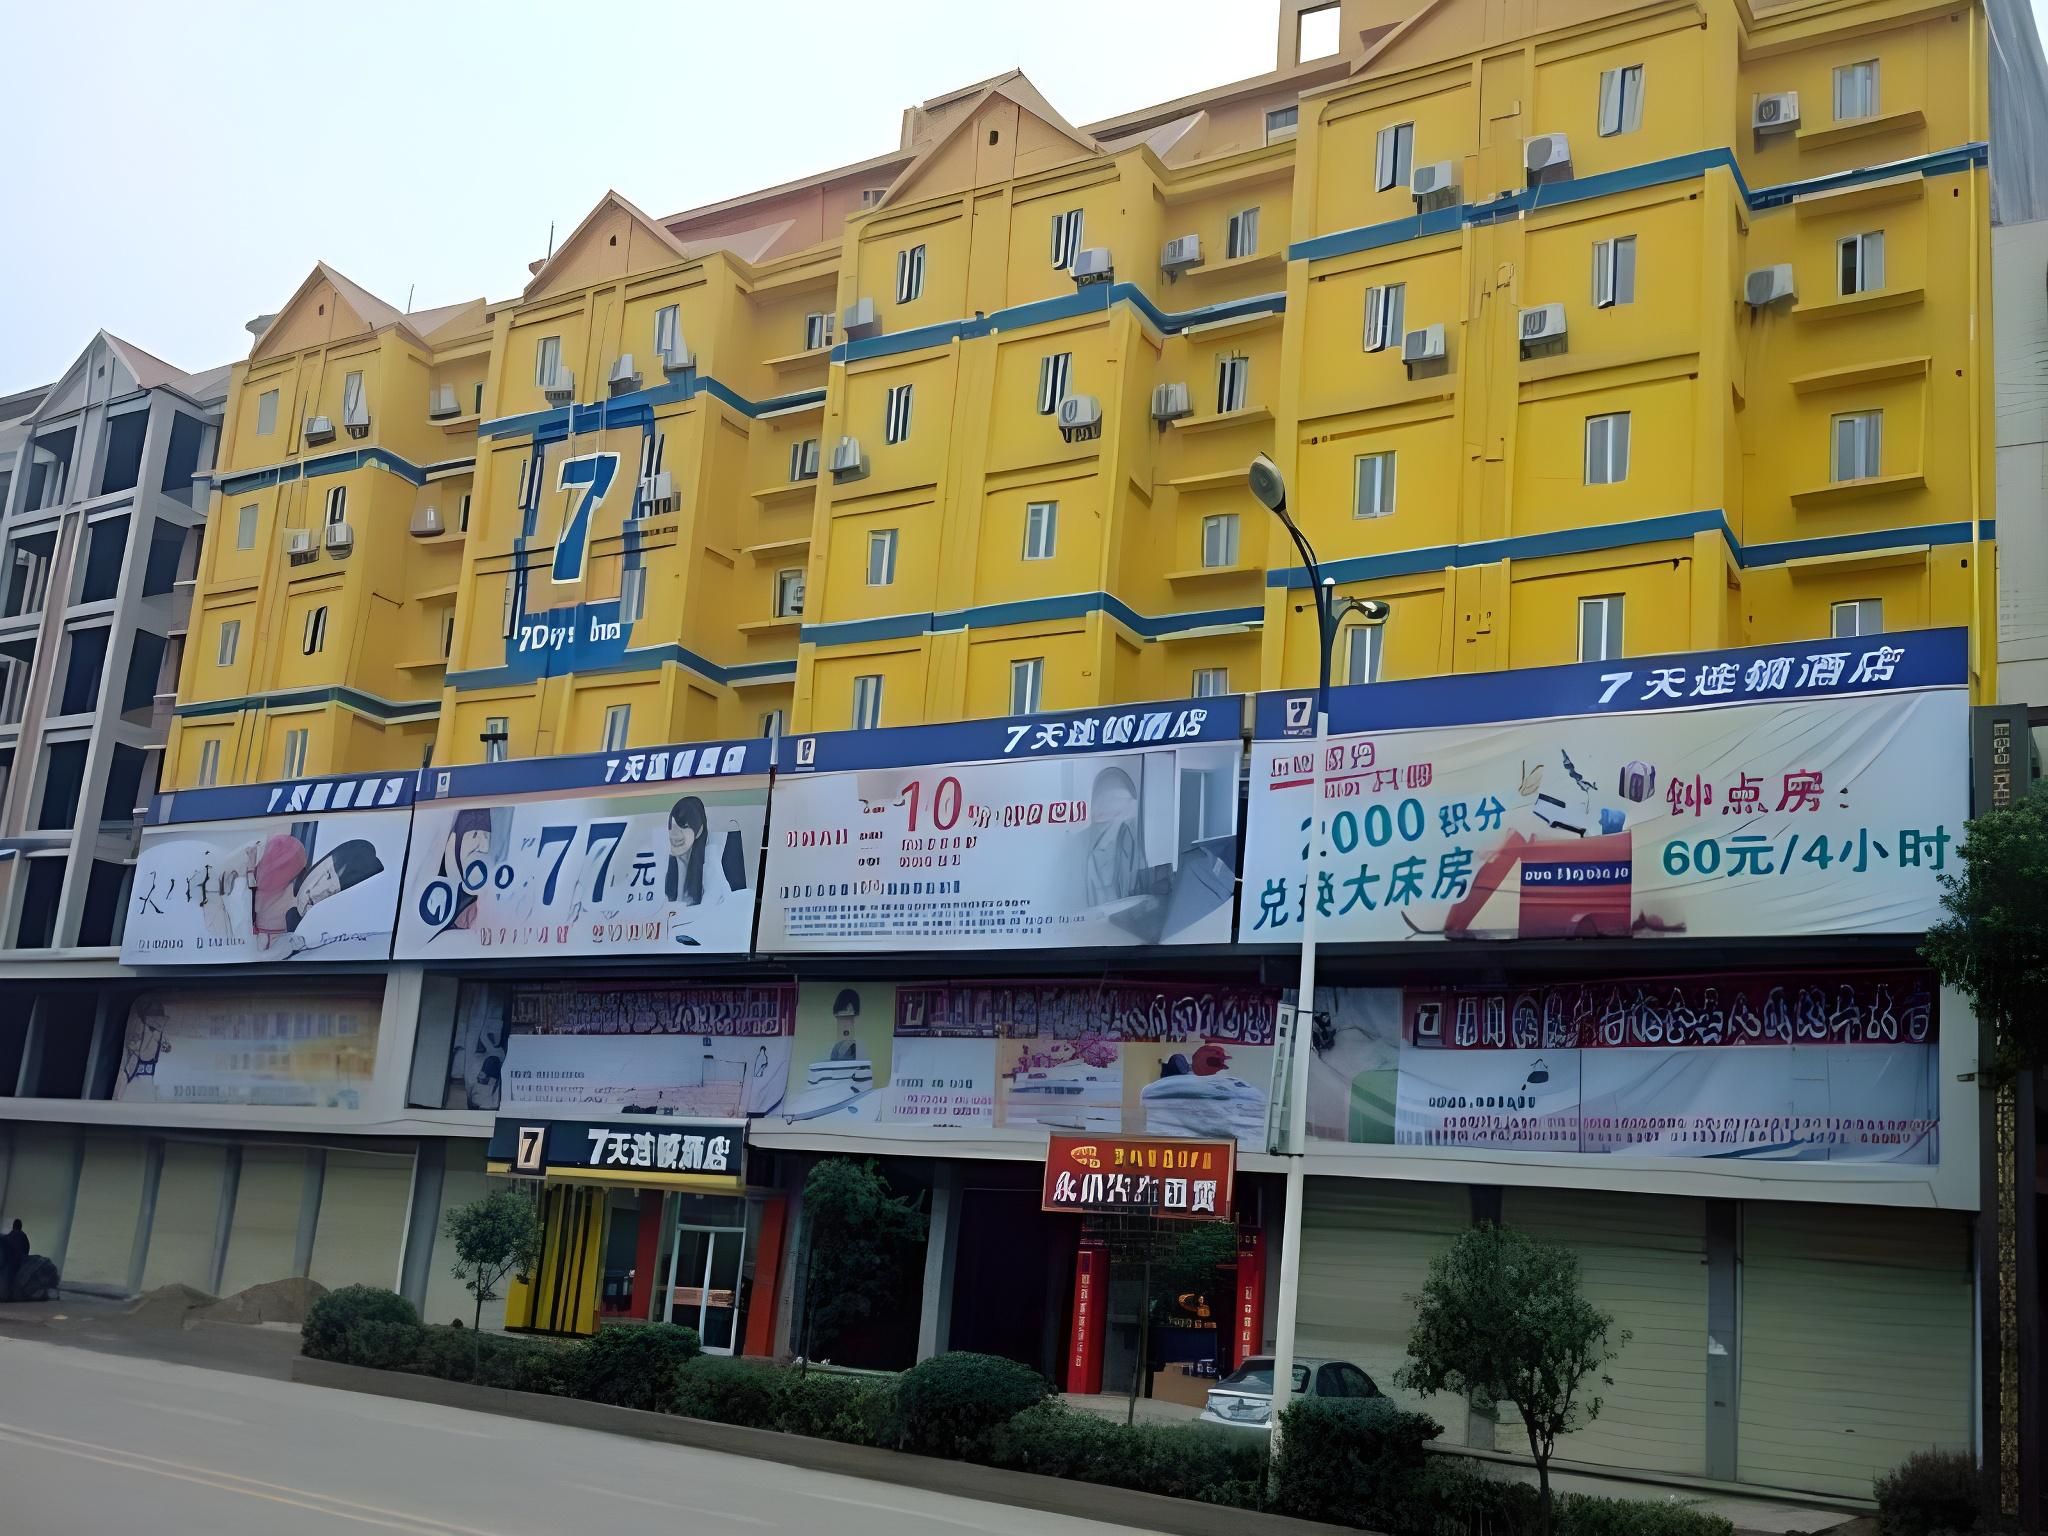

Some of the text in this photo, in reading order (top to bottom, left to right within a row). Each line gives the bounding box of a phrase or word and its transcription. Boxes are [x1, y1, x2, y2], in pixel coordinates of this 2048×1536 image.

[551, 452, 620, 584] 7
[1663, 825, 1951, 877] 60元/4小时
